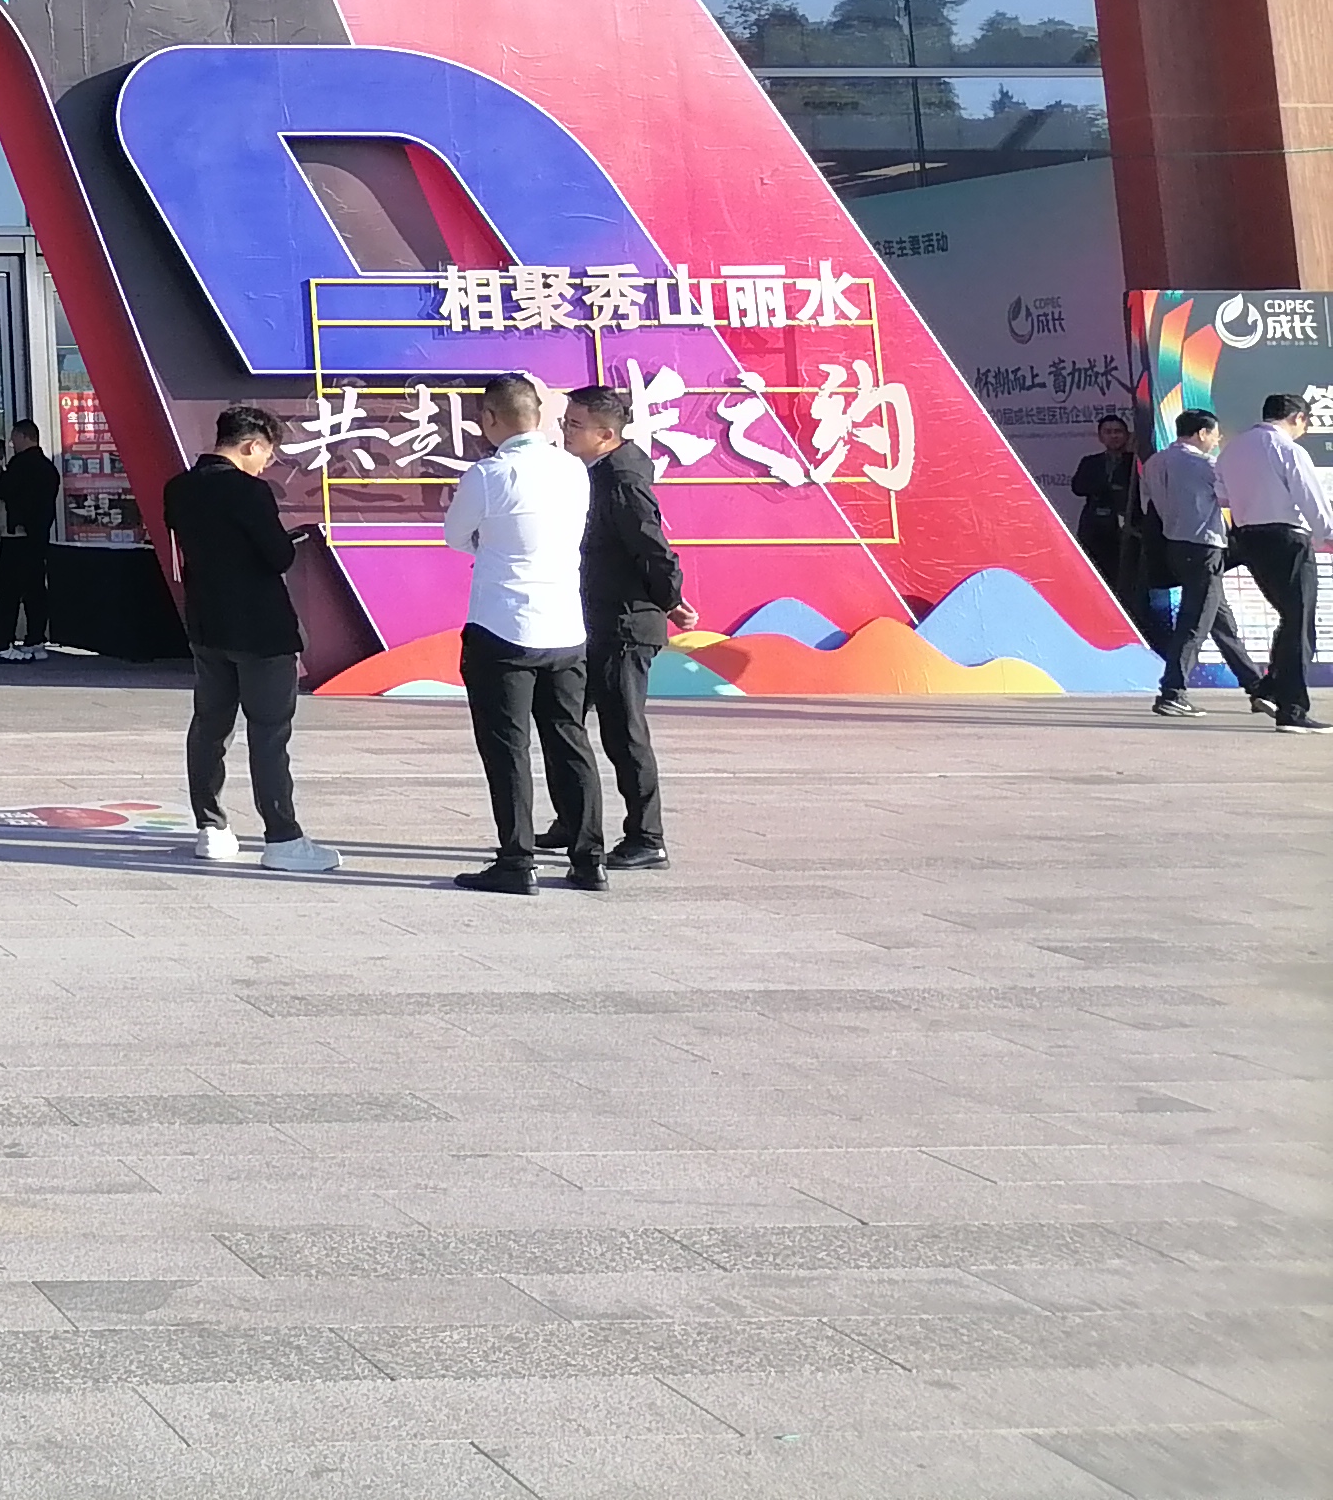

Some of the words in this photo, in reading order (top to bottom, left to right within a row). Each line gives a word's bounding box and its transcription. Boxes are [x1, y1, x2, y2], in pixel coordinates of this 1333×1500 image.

[438, 260, 863, 332] 相聚秀山丽水
[1264, 299, 1315, 313] CDPEC
[1035, 310, 1066, 334] 成长
[1266, 315, 1318, 340] 成长
